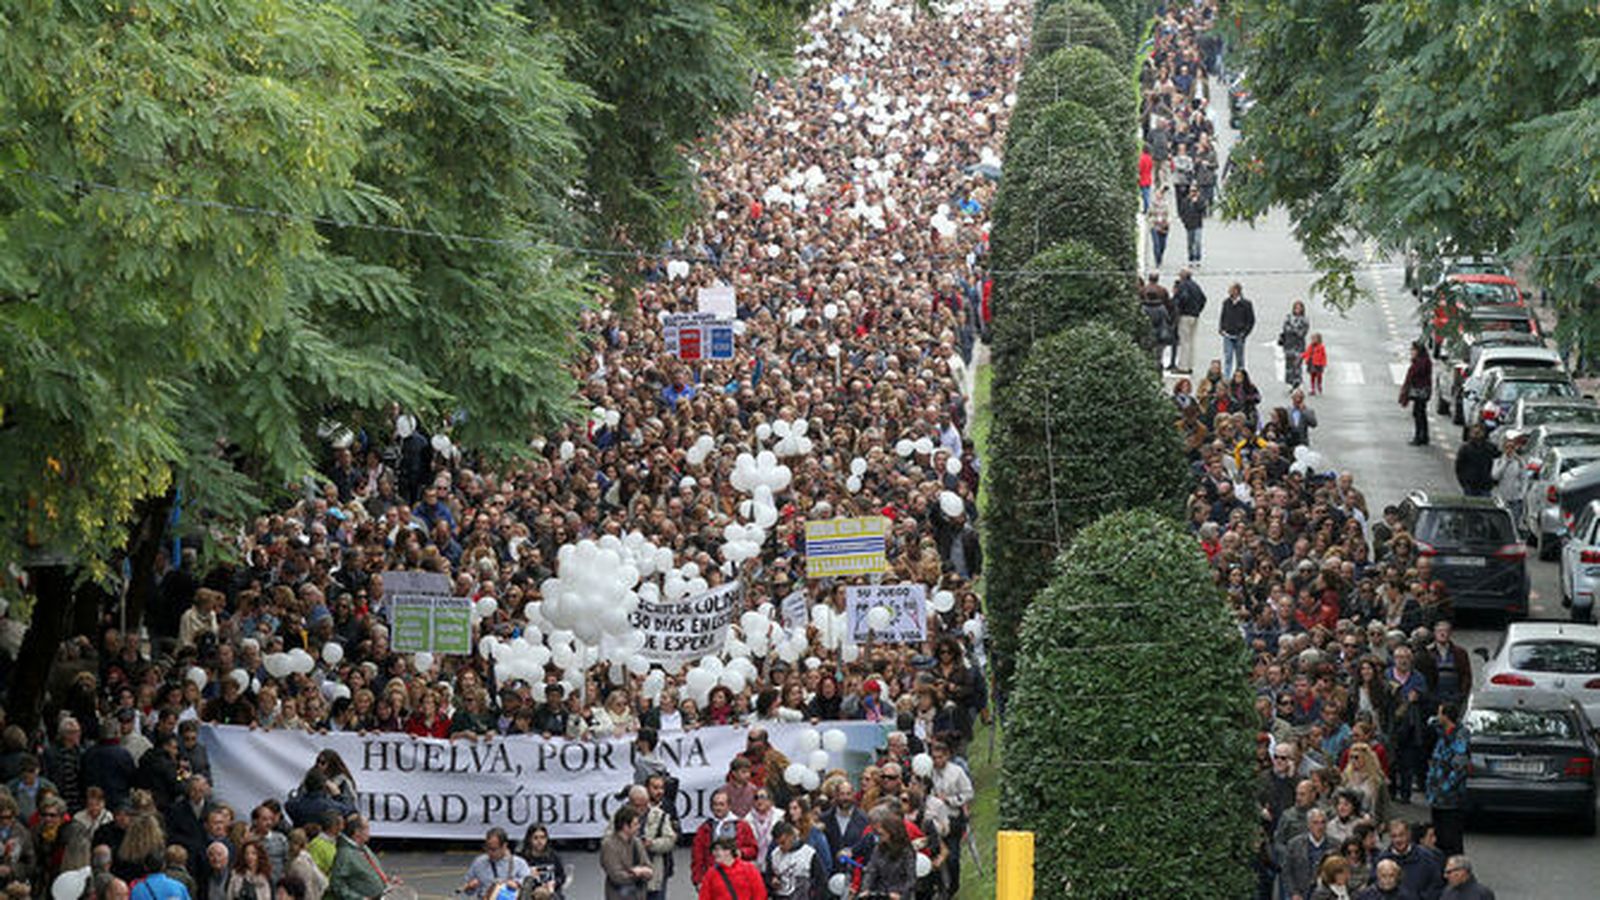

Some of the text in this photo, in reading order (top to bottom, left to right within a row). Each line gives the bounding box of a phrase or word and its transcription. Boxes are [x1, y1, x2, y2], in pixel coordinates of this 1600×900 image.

[360, 740, 522, 778] HUELVA,
[536, 742, 617, 772] POR
[482, 785, 614, 826] PÚBLIC
